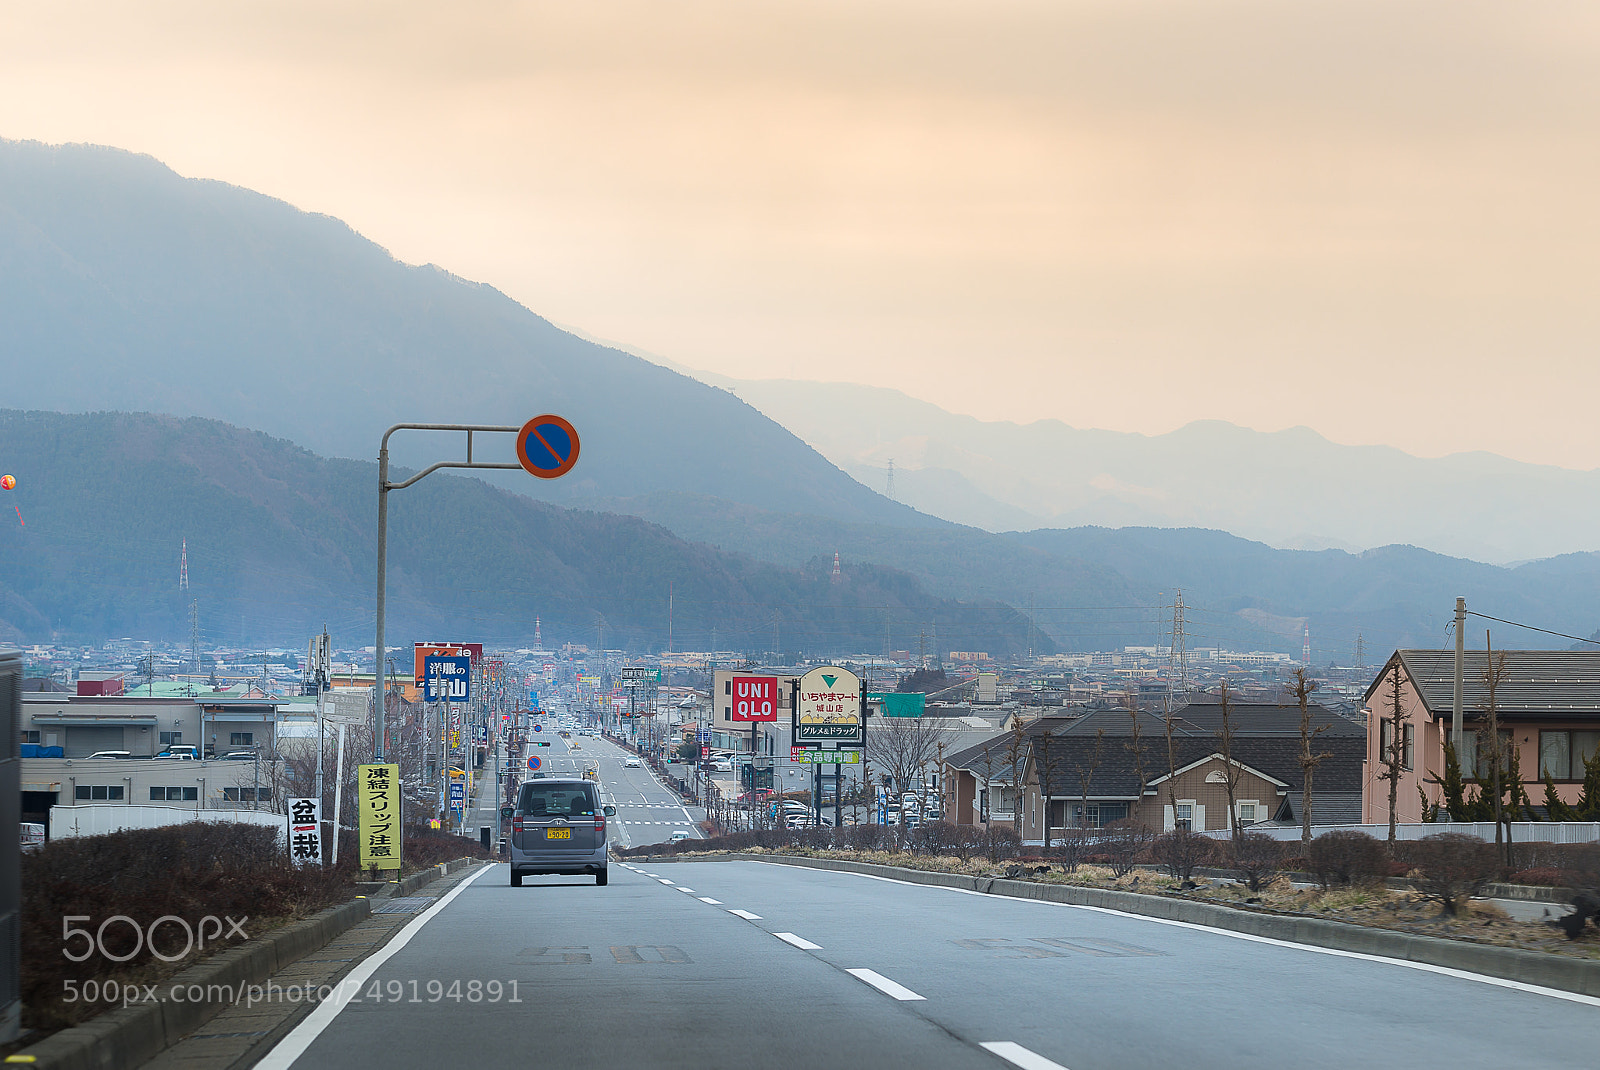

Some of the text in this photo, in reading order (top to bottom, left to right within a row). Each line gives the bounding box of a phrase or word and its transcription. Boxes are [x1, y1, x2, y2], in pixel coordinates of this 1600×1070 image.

[429, 662, 466, 675] 洋服の
[428, 677, 467, 697] 青山
[738, 682, 769, 698] UNI
[801, 692, 858, 702] いちやまマート
[737, 700, 772, 718] QLO
[816, 704, 844, 713] 城山店
[367, 768, 392, 857] 凍結スリップ注意
